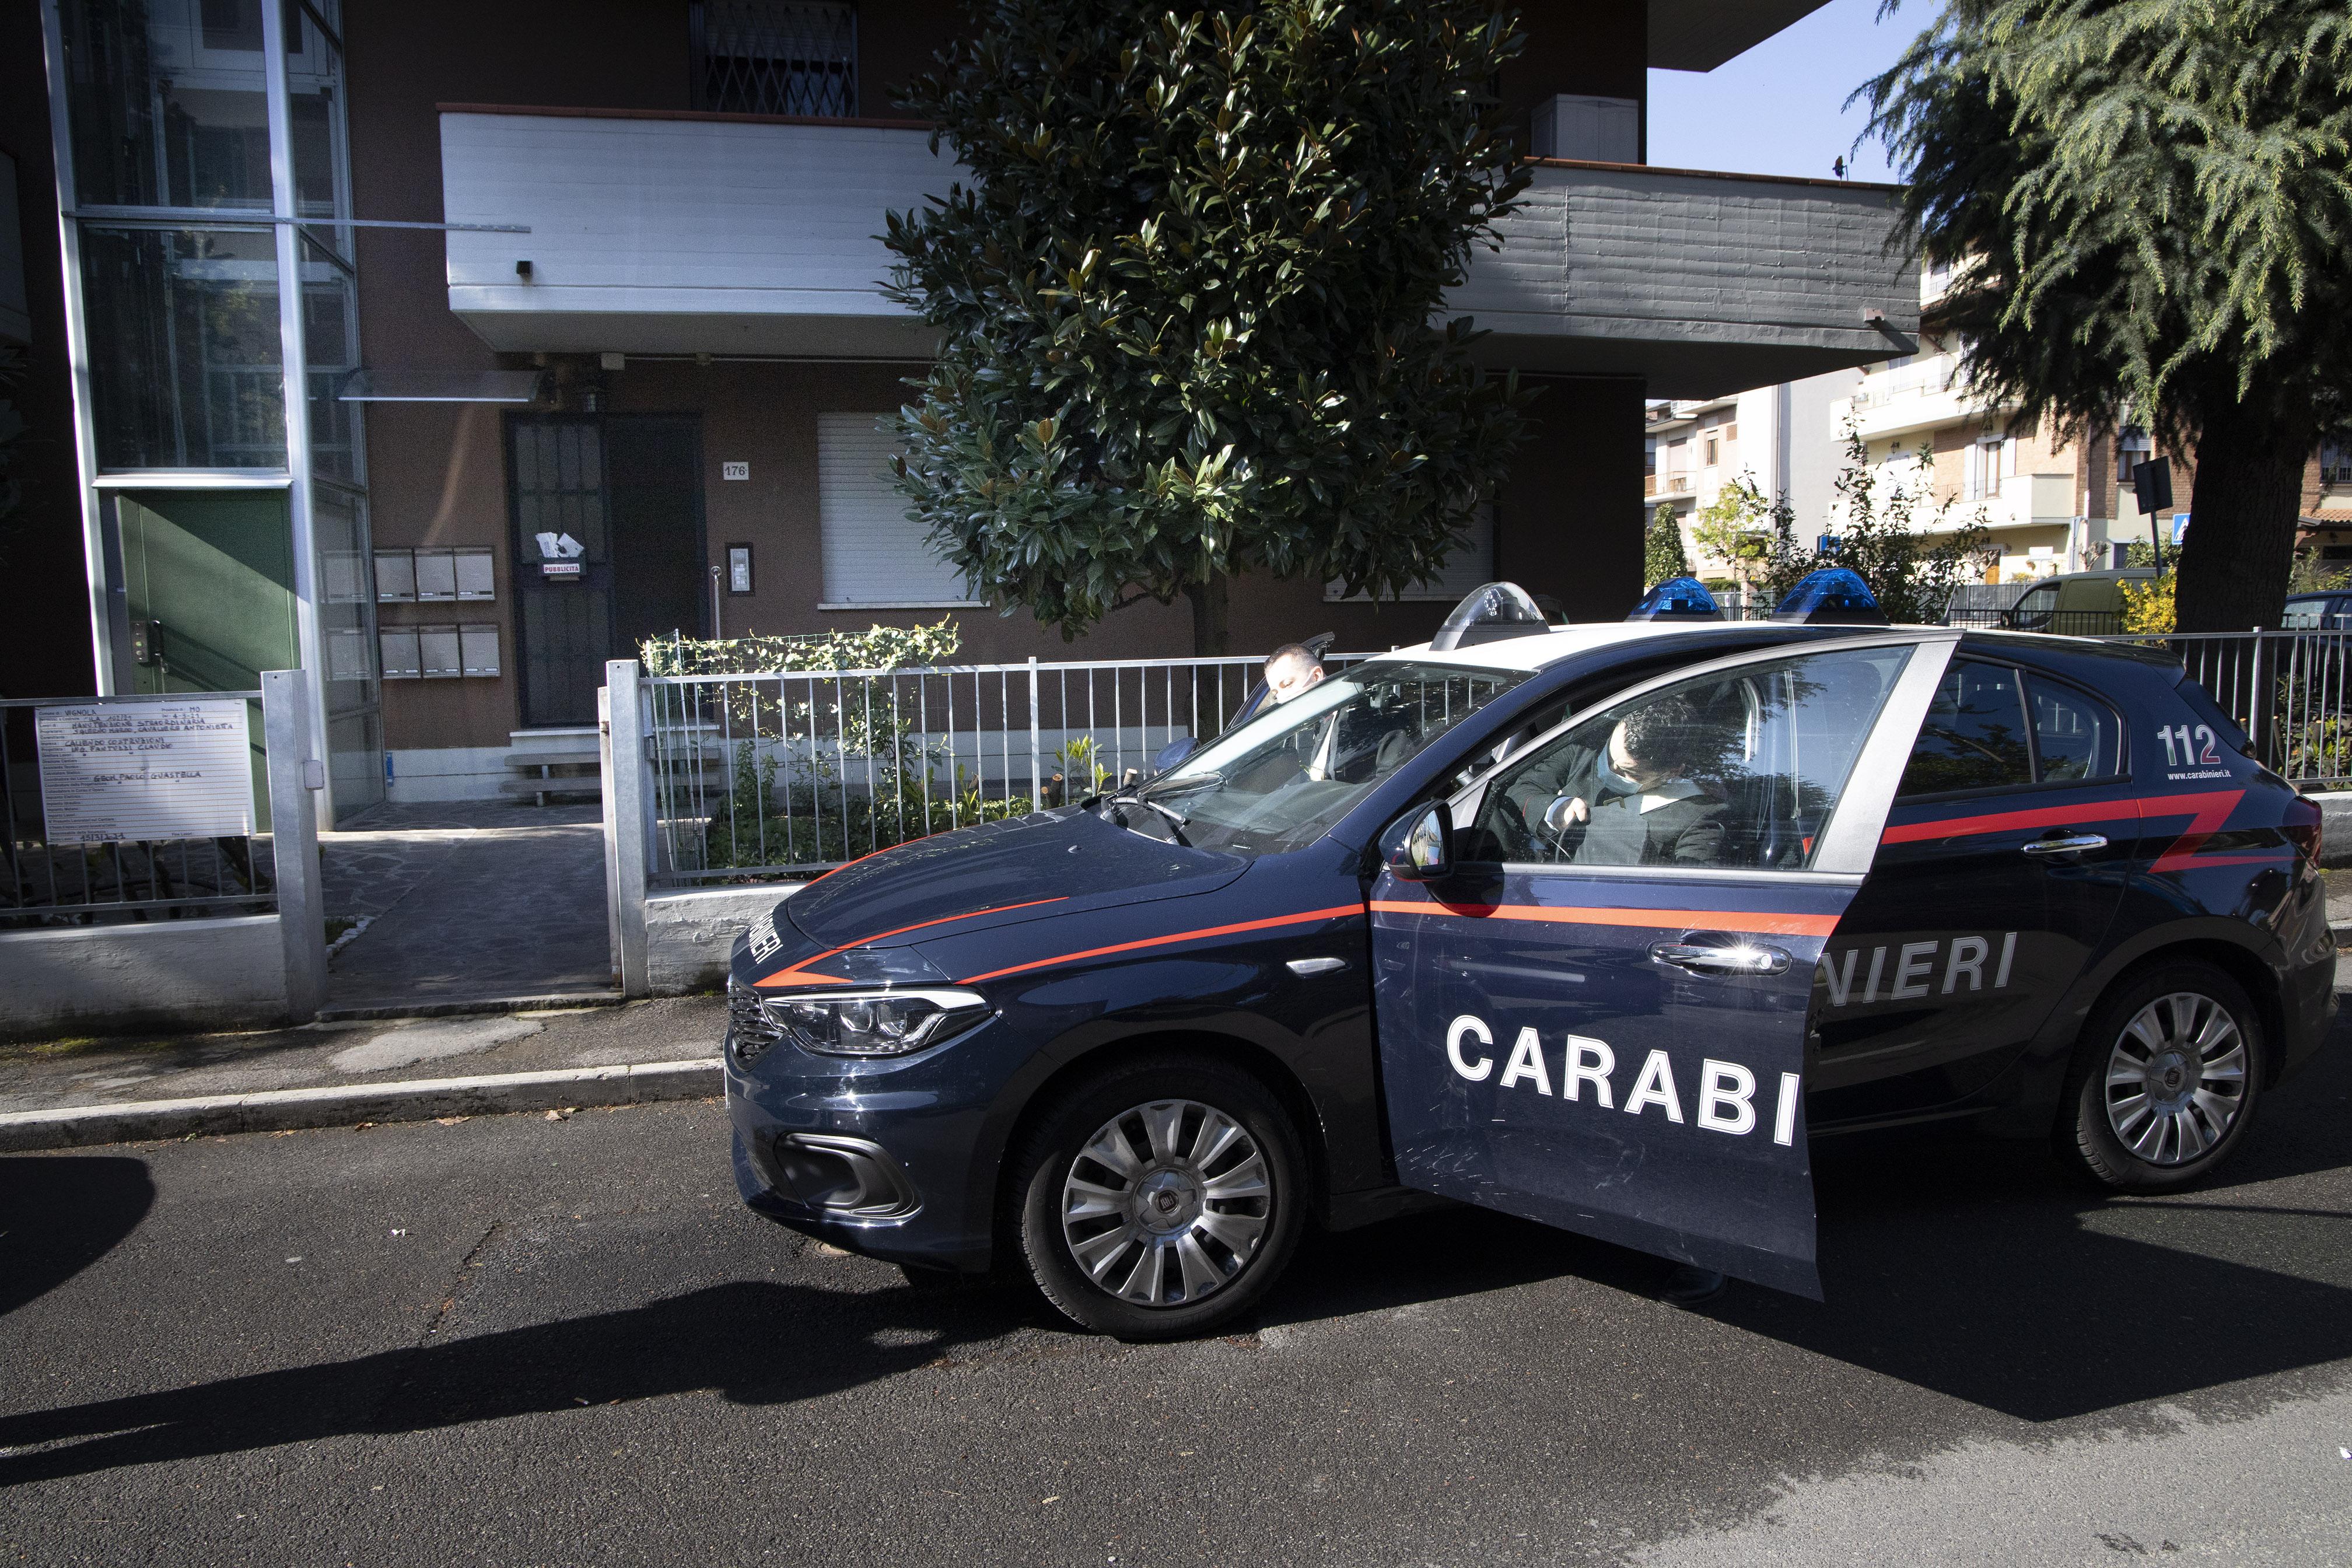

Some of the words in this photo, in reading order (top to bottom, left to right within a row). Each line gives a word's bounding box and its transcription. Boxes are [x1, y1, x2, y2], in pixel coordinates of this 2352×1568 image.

[725, 466, 746, 475] 176
[107, 737, 164, 745] COSTRUZIONI
[2157, 724, 2221, 765] 112
[150, 771, 201, 779] GUASTELLA
[2168, 769, 2231, 780] www.carabinieri.it
[1447, 1014, 1800, 1146] CARABI
[1160, 1195, 1174, 1209] FIAT
